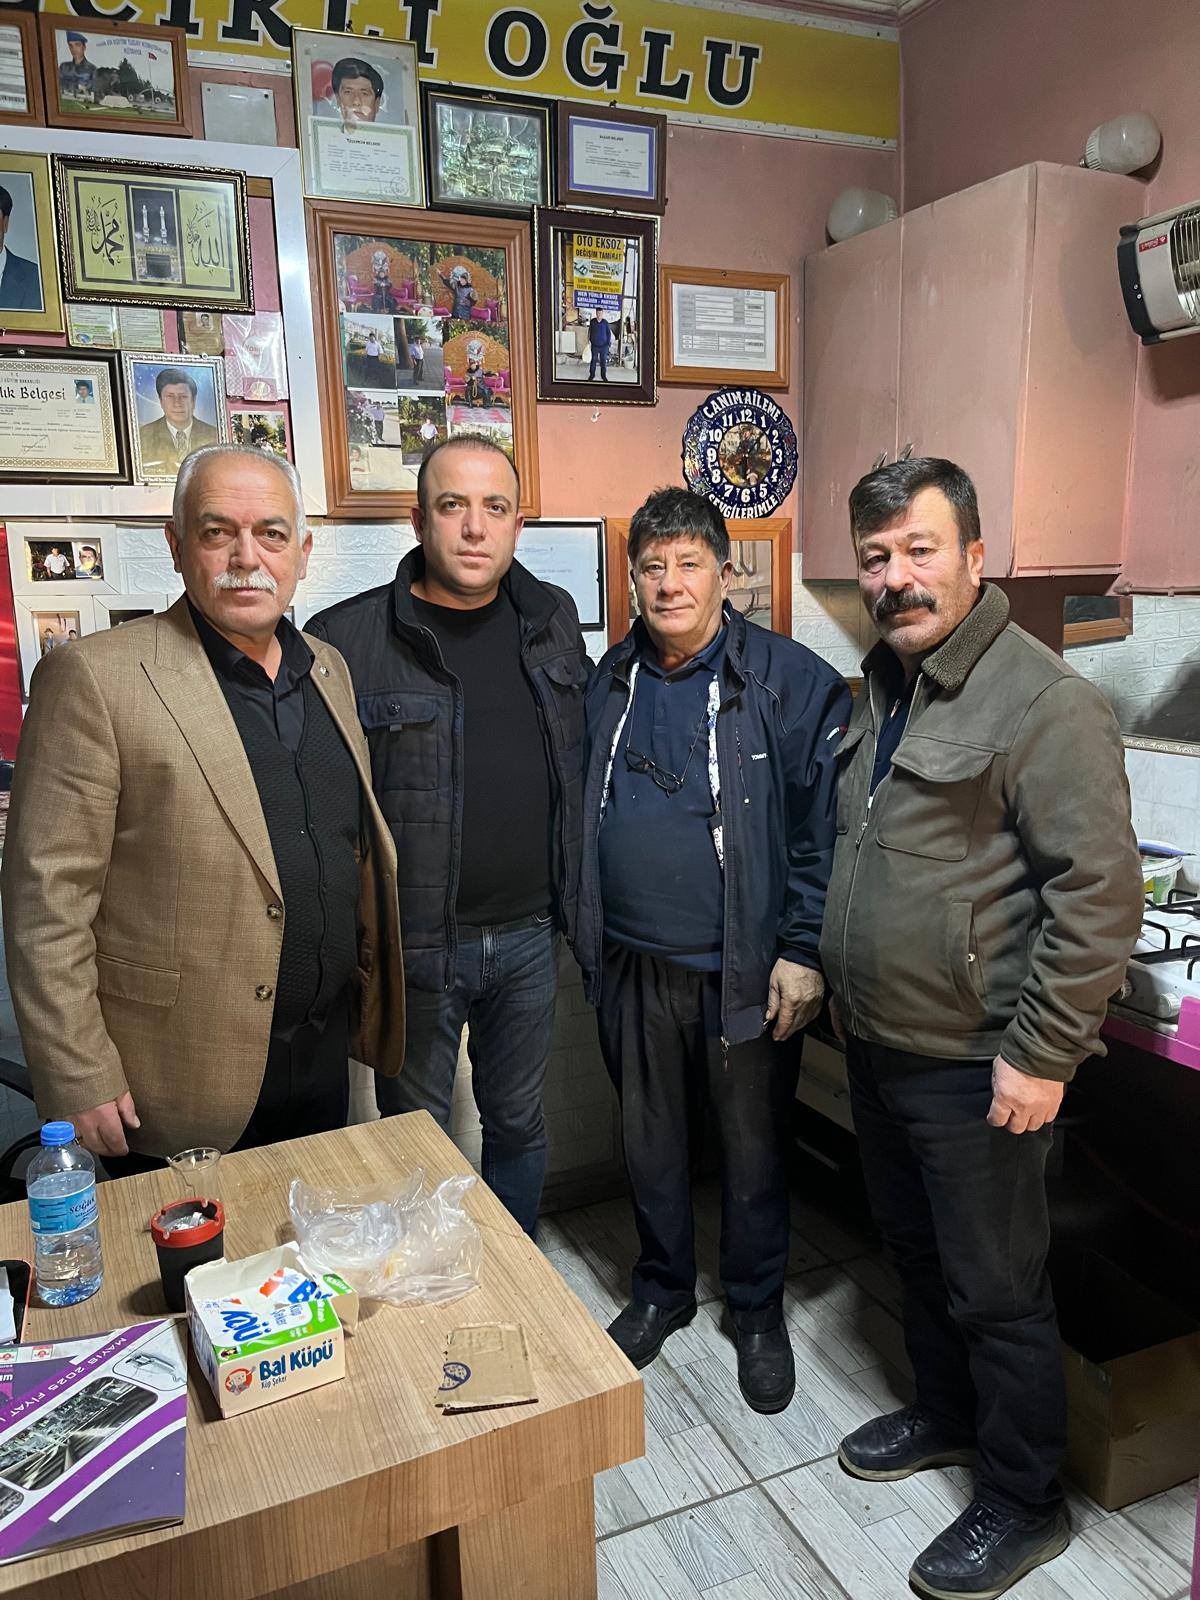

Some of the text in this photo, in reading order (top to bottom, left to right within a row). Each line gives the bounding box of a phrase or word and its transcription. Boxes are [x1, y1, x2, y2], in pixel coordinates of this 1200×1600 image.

[486, 0, 761, 107] OĞLU
[577, 235, 621, 250] OTO EKSOZ
[21, 386, 66, 404] Belgesi
[703, 390, 781, 421] CANIM AİLEME
[722, 413, 733, 427] 11
[740, 408, 753, 422] 12
[760, 415, 767, 428] 1
[709, 429, 723, 442] 10
[772, 429, 779, 443] 2
[706, 448, 717, 462] 9
[775, 449, 783, 464] 3
[711, 469, 721, 484] 8
[771, 469, 779, 482] 4
[724, 484, 734, 497] 7
[741, 488, 751, 503] 6
[759, 483, 767, 498] 5
[88, 1337, 127, 1365] MAYIS
[259, 1338, 333, 1381] Bal Küpü
[48, 1366, 85, 1391] 2025
[261, 1380, 272, 1390] Küp
